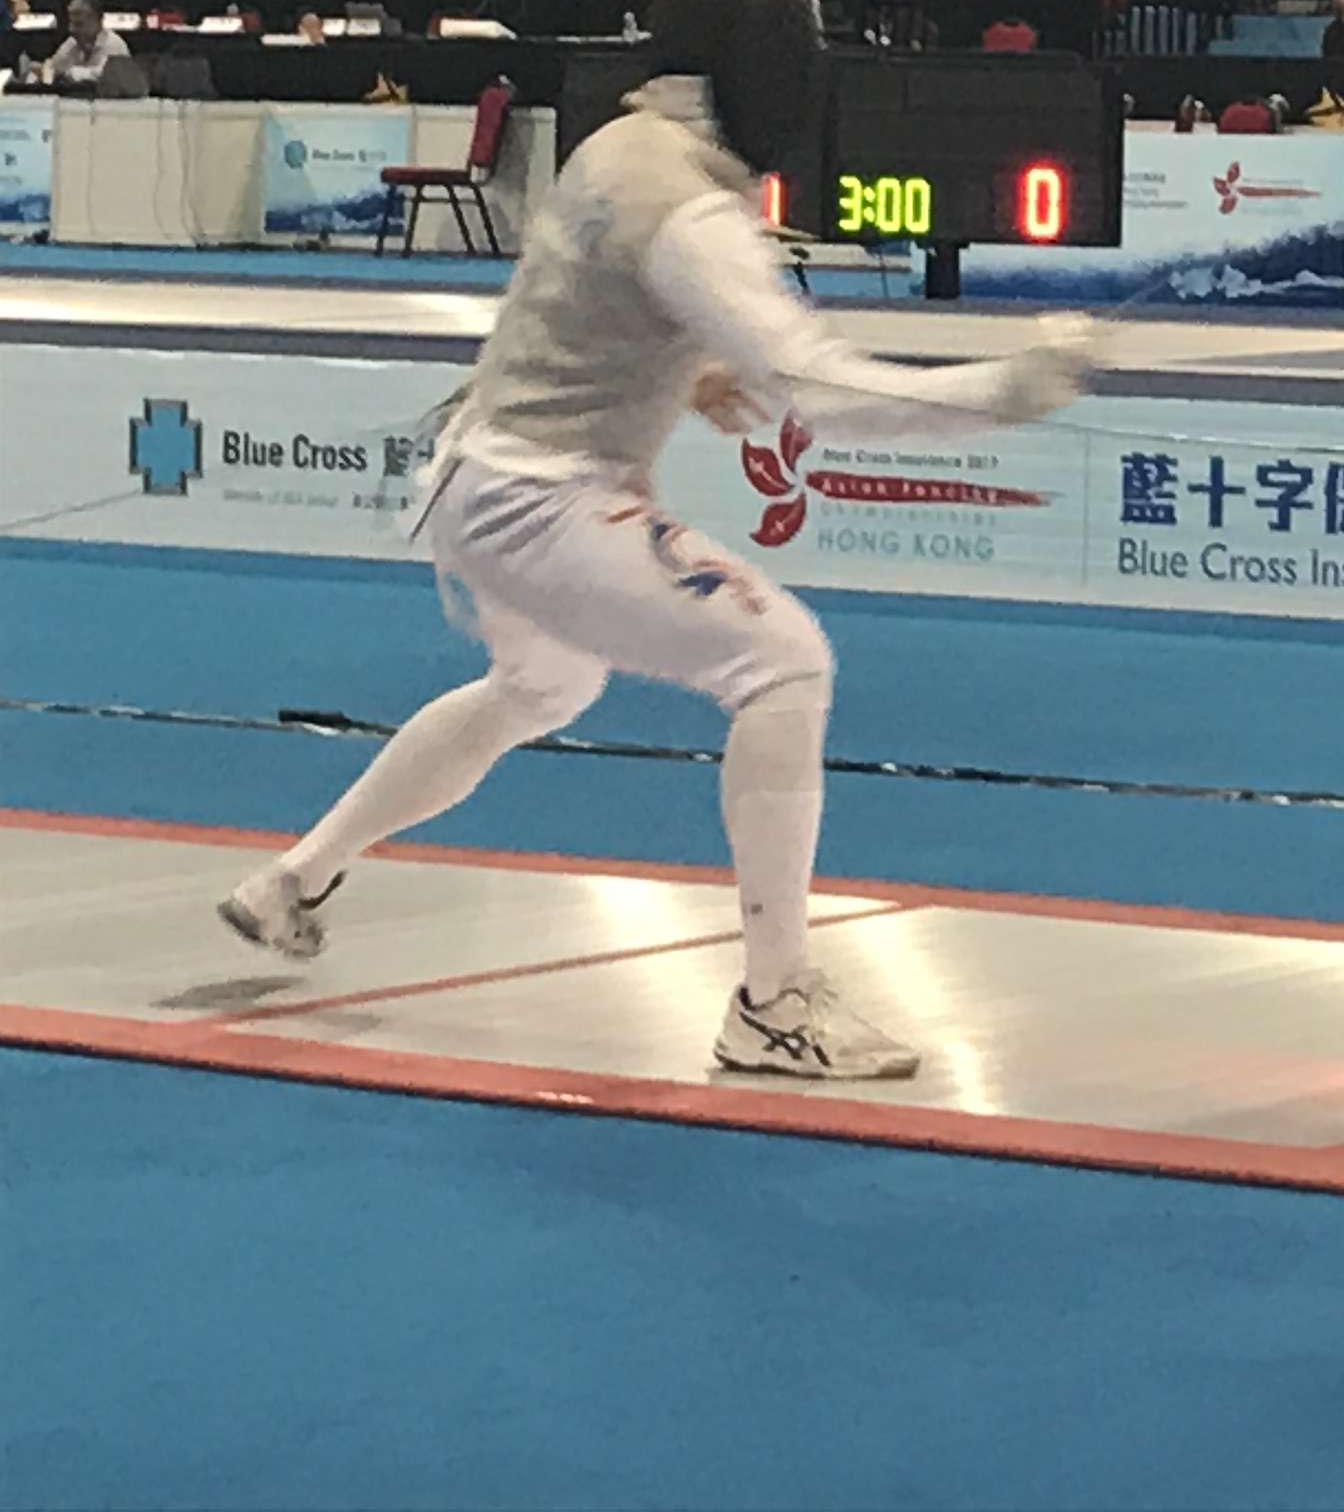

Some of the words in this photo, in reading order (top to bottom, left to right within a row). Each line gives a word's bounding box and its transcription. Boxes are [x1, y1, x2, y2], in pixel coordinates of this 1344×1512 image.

[838, 175, 932, 233] 3:00
[1026, 167, 1063, 237] 0
[222, 430, 284, 467] Blue
[292, 434, 368, 472] Cross
[817, 528, 901, 555] HONG
[911, 533, 996, 562] KONG
[1118, 537, 1189, 579] Blue
[1200, 542, 1298, 586] Cross
